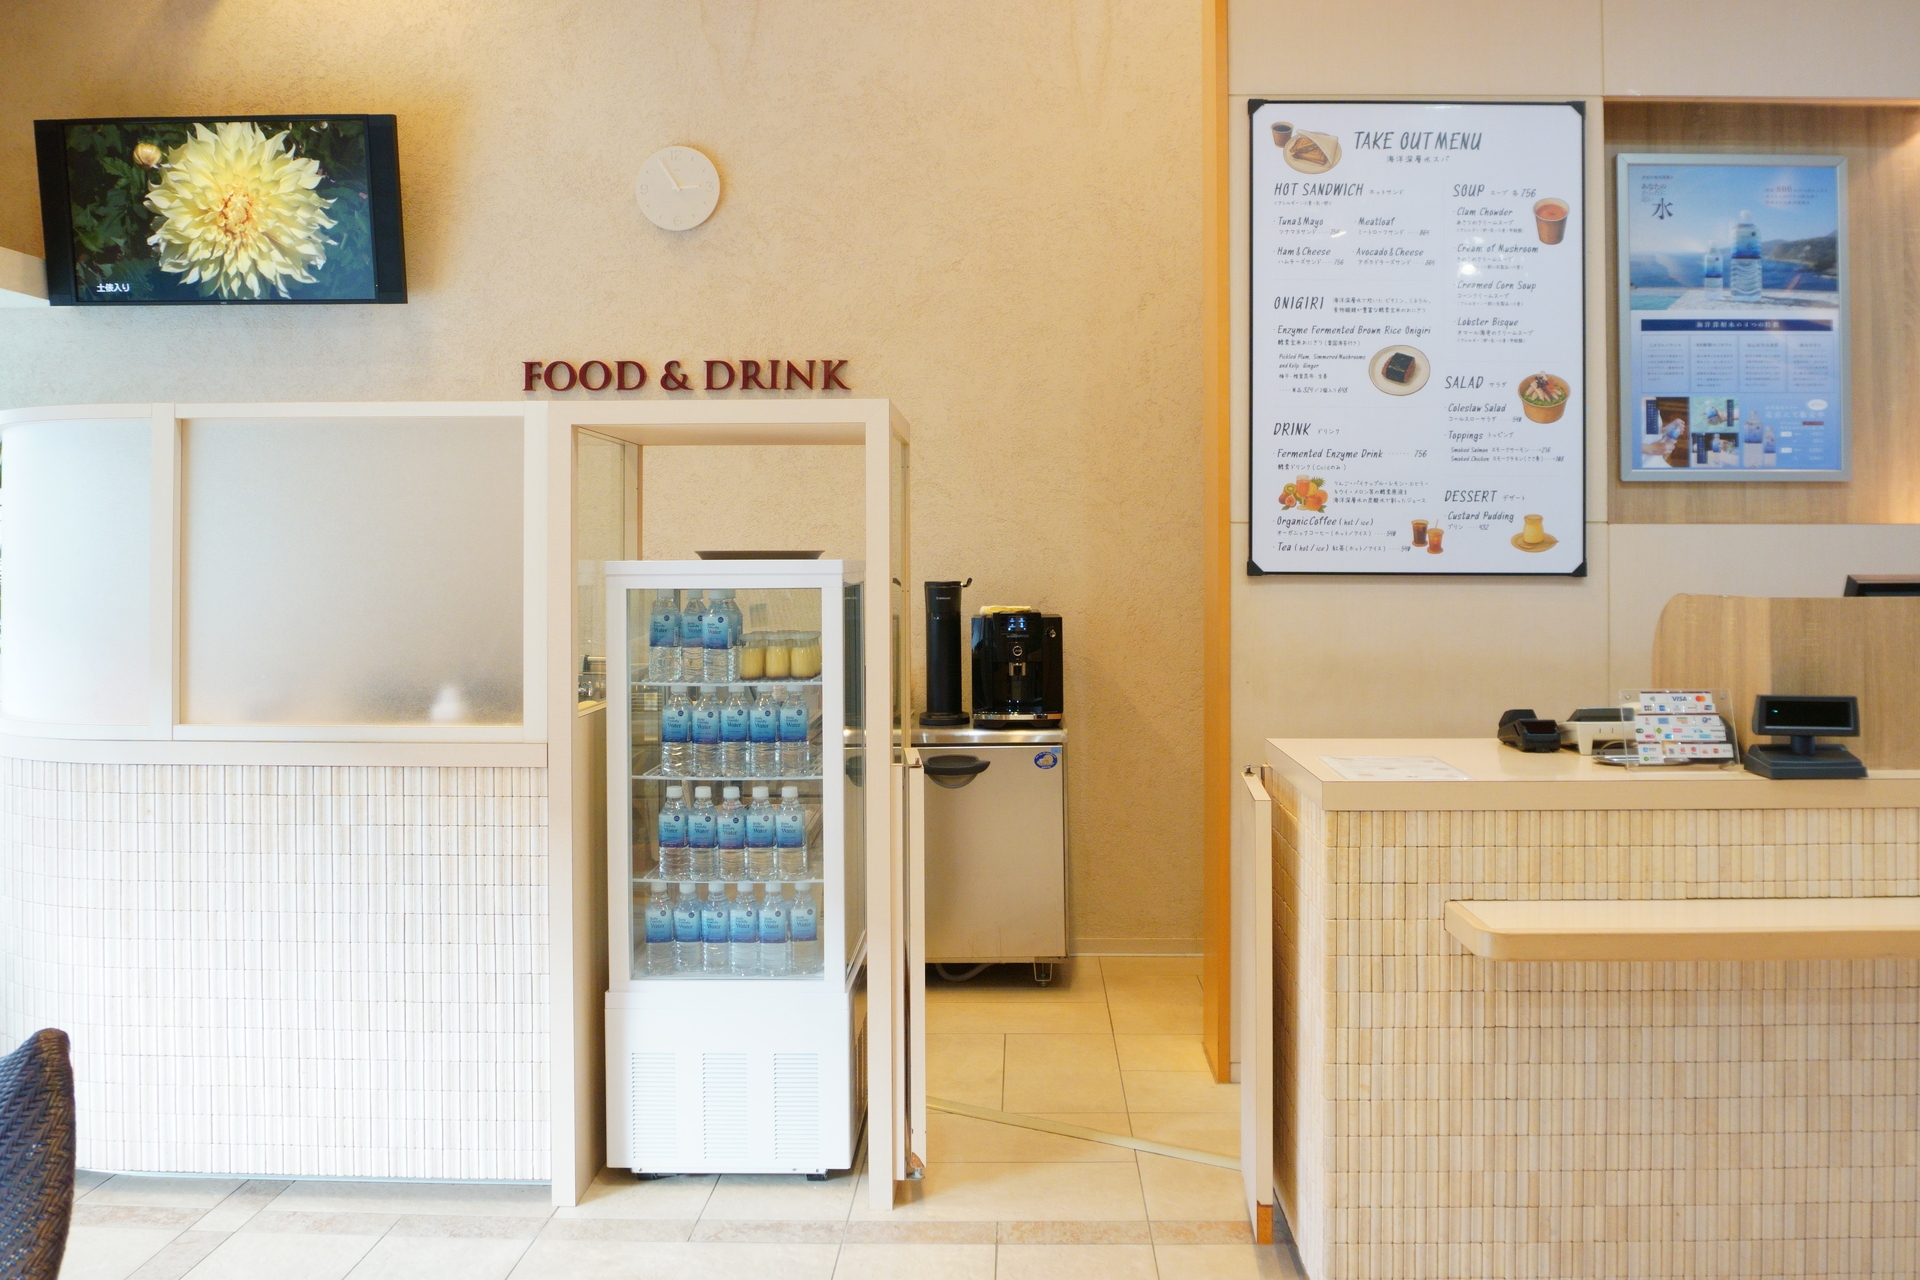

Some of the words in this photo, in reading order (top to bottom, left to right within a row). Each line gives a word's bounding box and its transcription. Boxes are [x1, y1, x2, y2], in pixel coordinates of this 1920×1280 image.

[1354, 131, 1394, 150] TAKE
[1400, 132, 1434, 150] OUT
[1434, 132, 1482, 150] MENU
[671, 150, 682, 161] 12
[1386, 155, 1450, 163] 海洋深層水スパ
[640, 184, 648, 194] 9
[706, 181, 714, 192] 3
[1274, 183, 1299, 196] HOT
[1302, 183, 1364, 196] SANDWICH
[1453, 184, 1485, 197] SOUP
[1521, 189, 1536, 197] 756
[1457, 207, 1476, 216] Clam
[1480, 207, 1513, 216] Chowder
[1652, 198, 1673, 220] 水
[674, 216, 682, 226] 6
[1358, 217, 1396, 225] Meatloaf
[1457, 244, 1482, 252] Cream
[1487, 244, 1495, 252] of
[1498, 244, 1539, 253] Mushroom
[1457, 281, 1493, 289] Creamed
[1496, 281, 1514, 289] Corn
[1518, 281, 1537, 292] Soup
[1274, 297, 1324, 309] ONIGIRI
[1457, 317, 1489, 326] Lobster
[1492, 317, 1519, 329] Bisque
[1277, 325, 1308, 337] Enzyme
[1311, 325, 1355, 334] Fermented
[1358, 326, 1381, 335] Brown
[1384, 326, 1401, 334] Rice
[1405, 326, 1432, 337] Onigiri
[522, 360, 648, 391] FOOD
[660, 360, 694, 391] &
[703, 360, 852, 391] DRINK
[1445, 376, 1484, 389] SALAD
[1448, 403, 1482, 412] Coleslaw
[1484, 403, 1506, 412] Salad
[1273, 423, 1311, 436] DRINK
[1448, 431, 1483, 442] Toppings
[1277, 449, 1323, 458] Fermented
[1326, 449, 1358, 461] Enzyme
[1361, 449, 1383, 458] Drink
[1444, 490, 1497, 502] DESSERT
[1277, 516, 1308, 528] Organic
[1310, 517, 1337, 526] Coffee
[1448, 511, 1480, 520] Custard
[1483, 511, 1514, 523] Pudding
[1278, 542, 1291, 551] Tea
